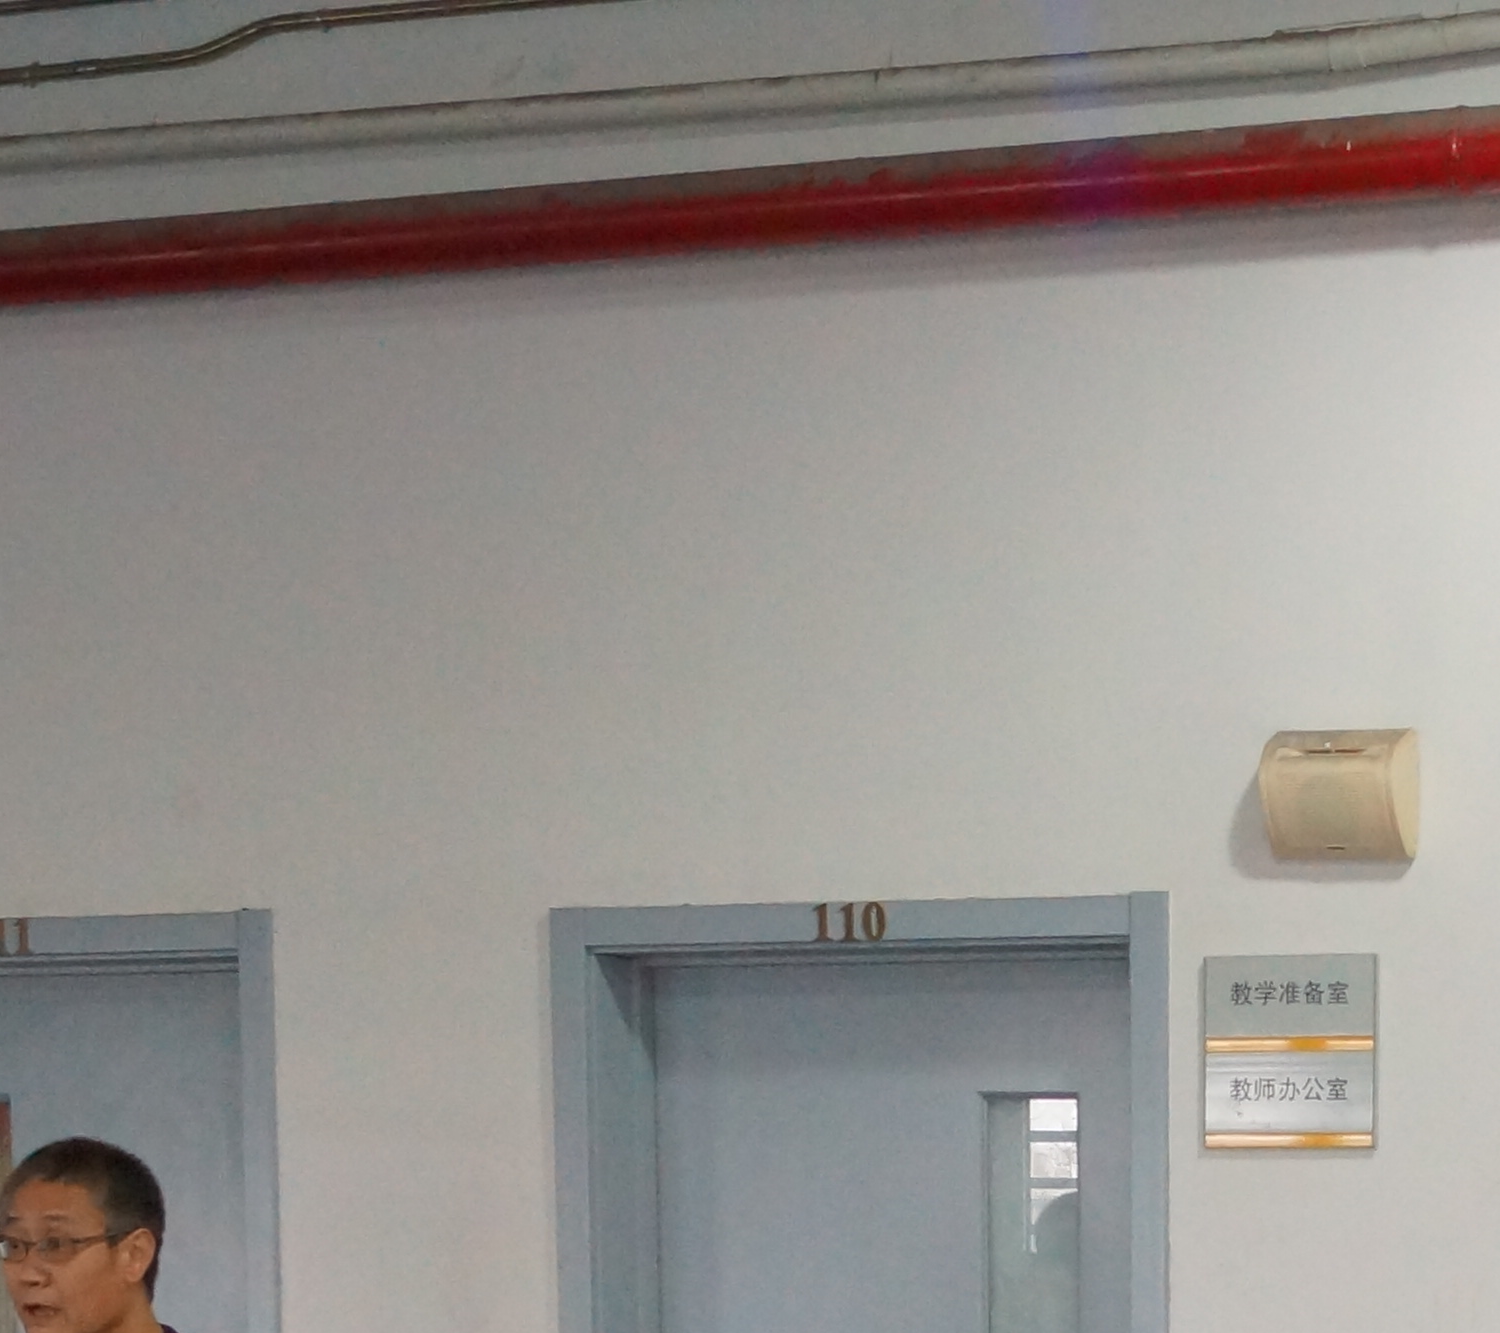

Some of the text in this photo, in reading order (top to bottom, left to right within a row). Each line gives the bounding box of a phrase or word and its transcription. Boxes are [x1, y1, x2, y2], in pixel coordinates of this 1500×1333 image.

[812, 901, 886, 942] 110
[1230, 980, 1349, 1006] 教学准备室
[1230, 1077, 1348, 1101] 教师办公室
